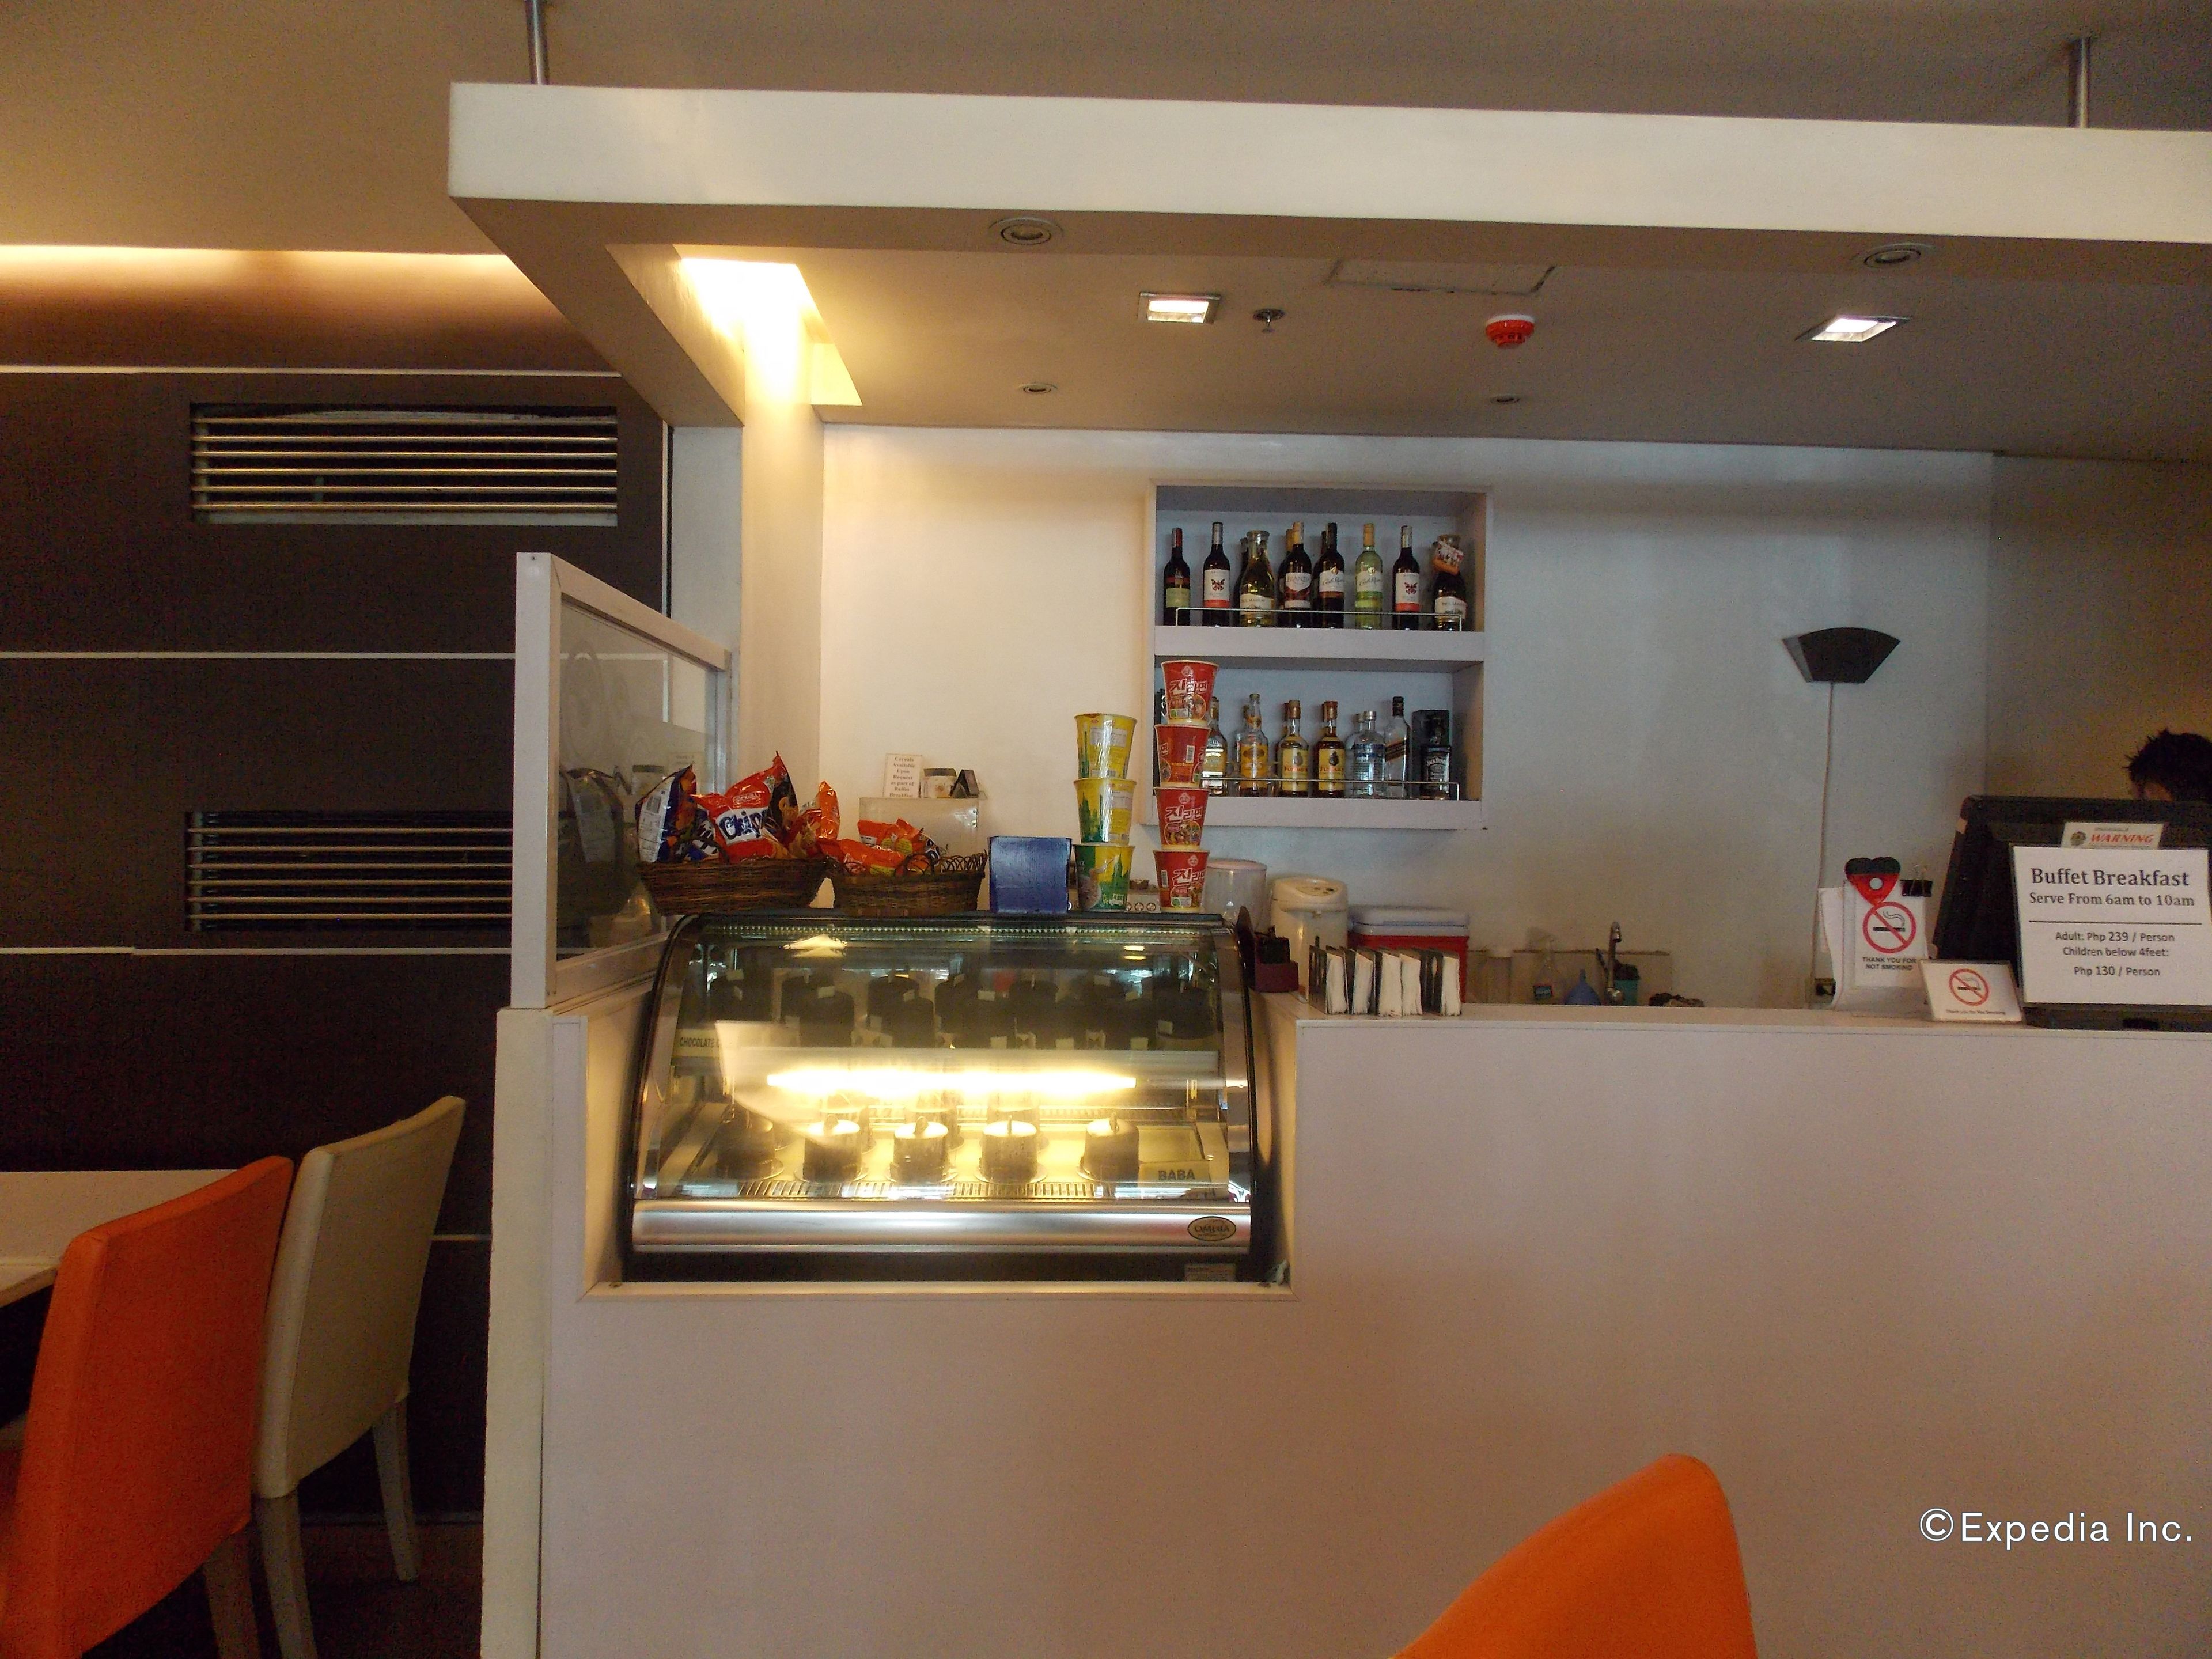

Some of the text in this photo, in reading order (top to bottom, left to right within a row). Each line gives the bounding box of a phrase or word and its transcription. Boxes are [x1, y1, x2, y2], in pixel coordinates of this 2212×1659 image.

[1165, 805, 1203, 824] 진라면
[2090, 834, 2155, 843] WARNING
[2031, 868, 2190, 886] Buffet Breakfast
[2029, 892, 2195, 907] Serve From 6am to 10am
[2055, 932, 2175, 943] Adult: Php 239 / Person
[2063, 947, 2169, 957] Children below 4feet:
[2073, 966, 2161, 977] Php 130 / Person
[680, 1037, 714, 1048] CHOCOLATE
[1158, 1169, 1196, 1181] BABA
